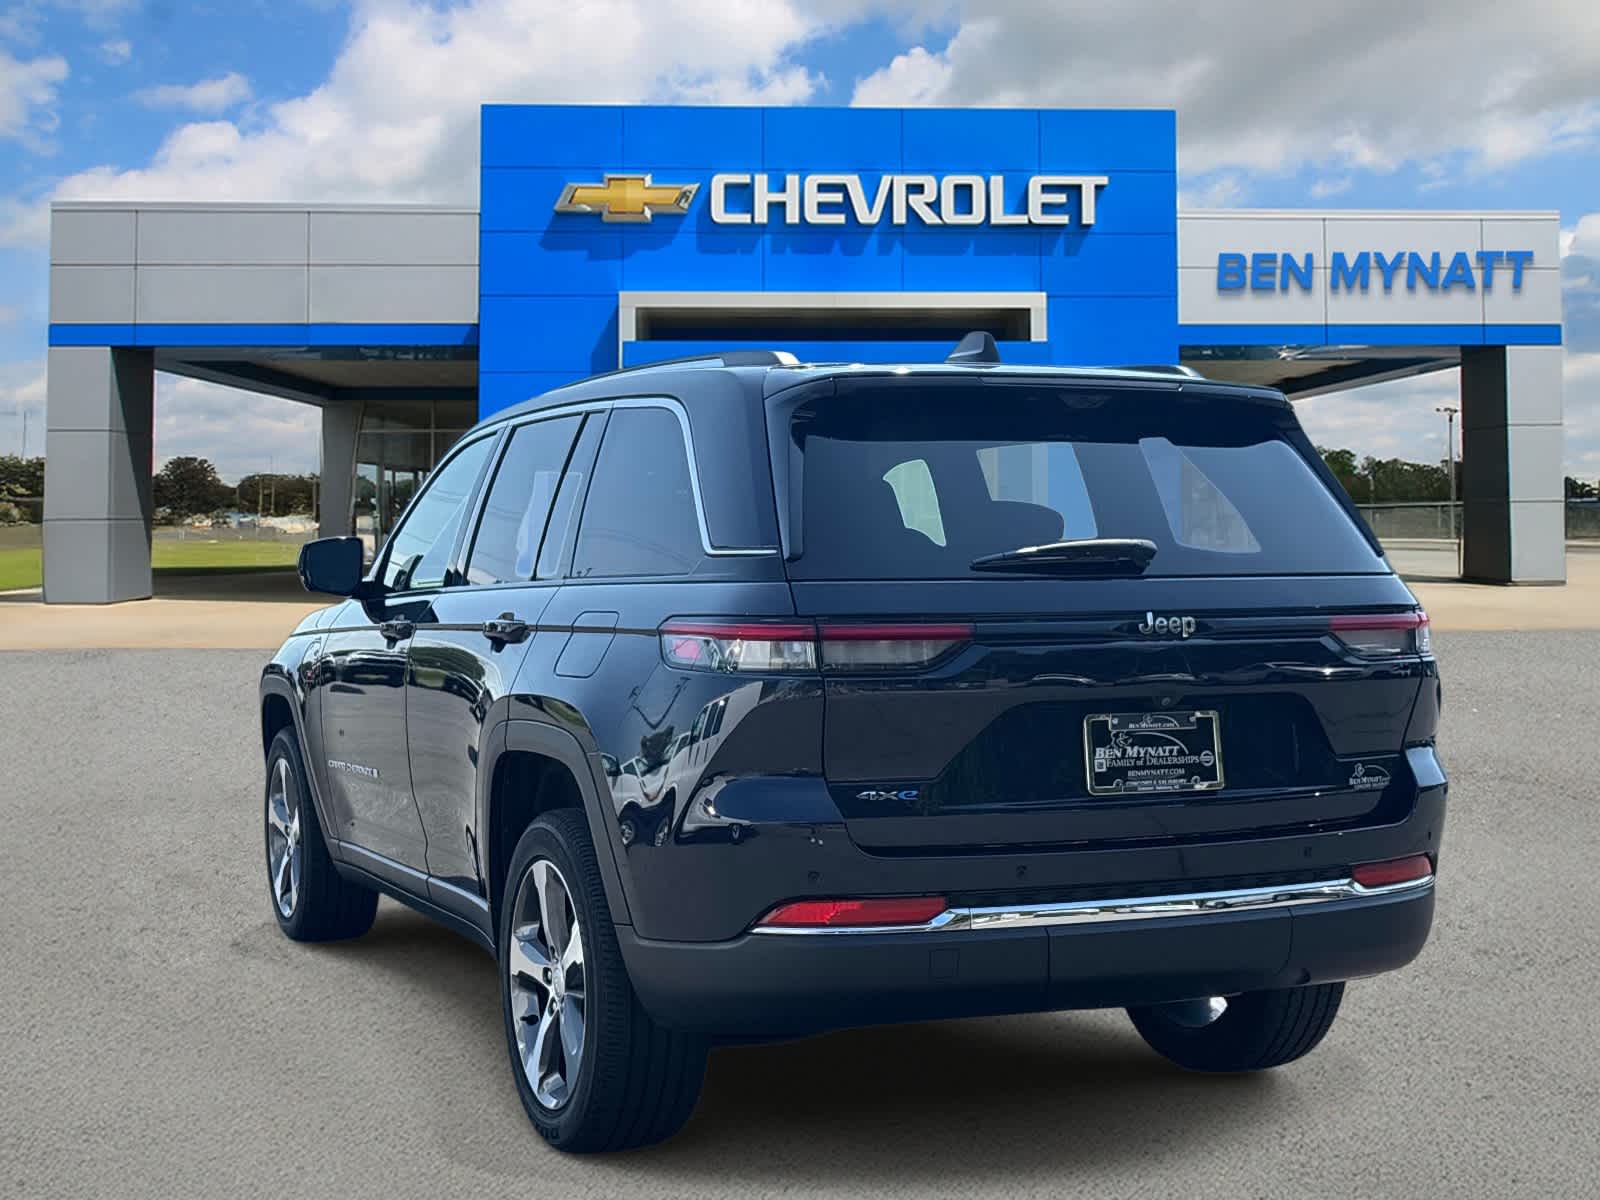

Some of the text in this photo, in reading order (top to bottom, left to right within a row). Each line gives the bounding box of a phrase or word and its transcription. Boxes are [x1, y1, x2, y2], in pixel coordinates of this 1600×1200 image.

[711, 173, 1109, 225] CHEVROLET
[1217, 250, 1535, 290] BEN MYNATT
[1138, 611, 1197, 638] Jeep
[1095, 746, 1179, 759] BEN MYNATT
[1106, 758, 1136, 768] FAMILY
[1146, 755, 1200, 767] DEALERSHIPS
[1127, 768, 1185, 777] BENMYNATT.COM
